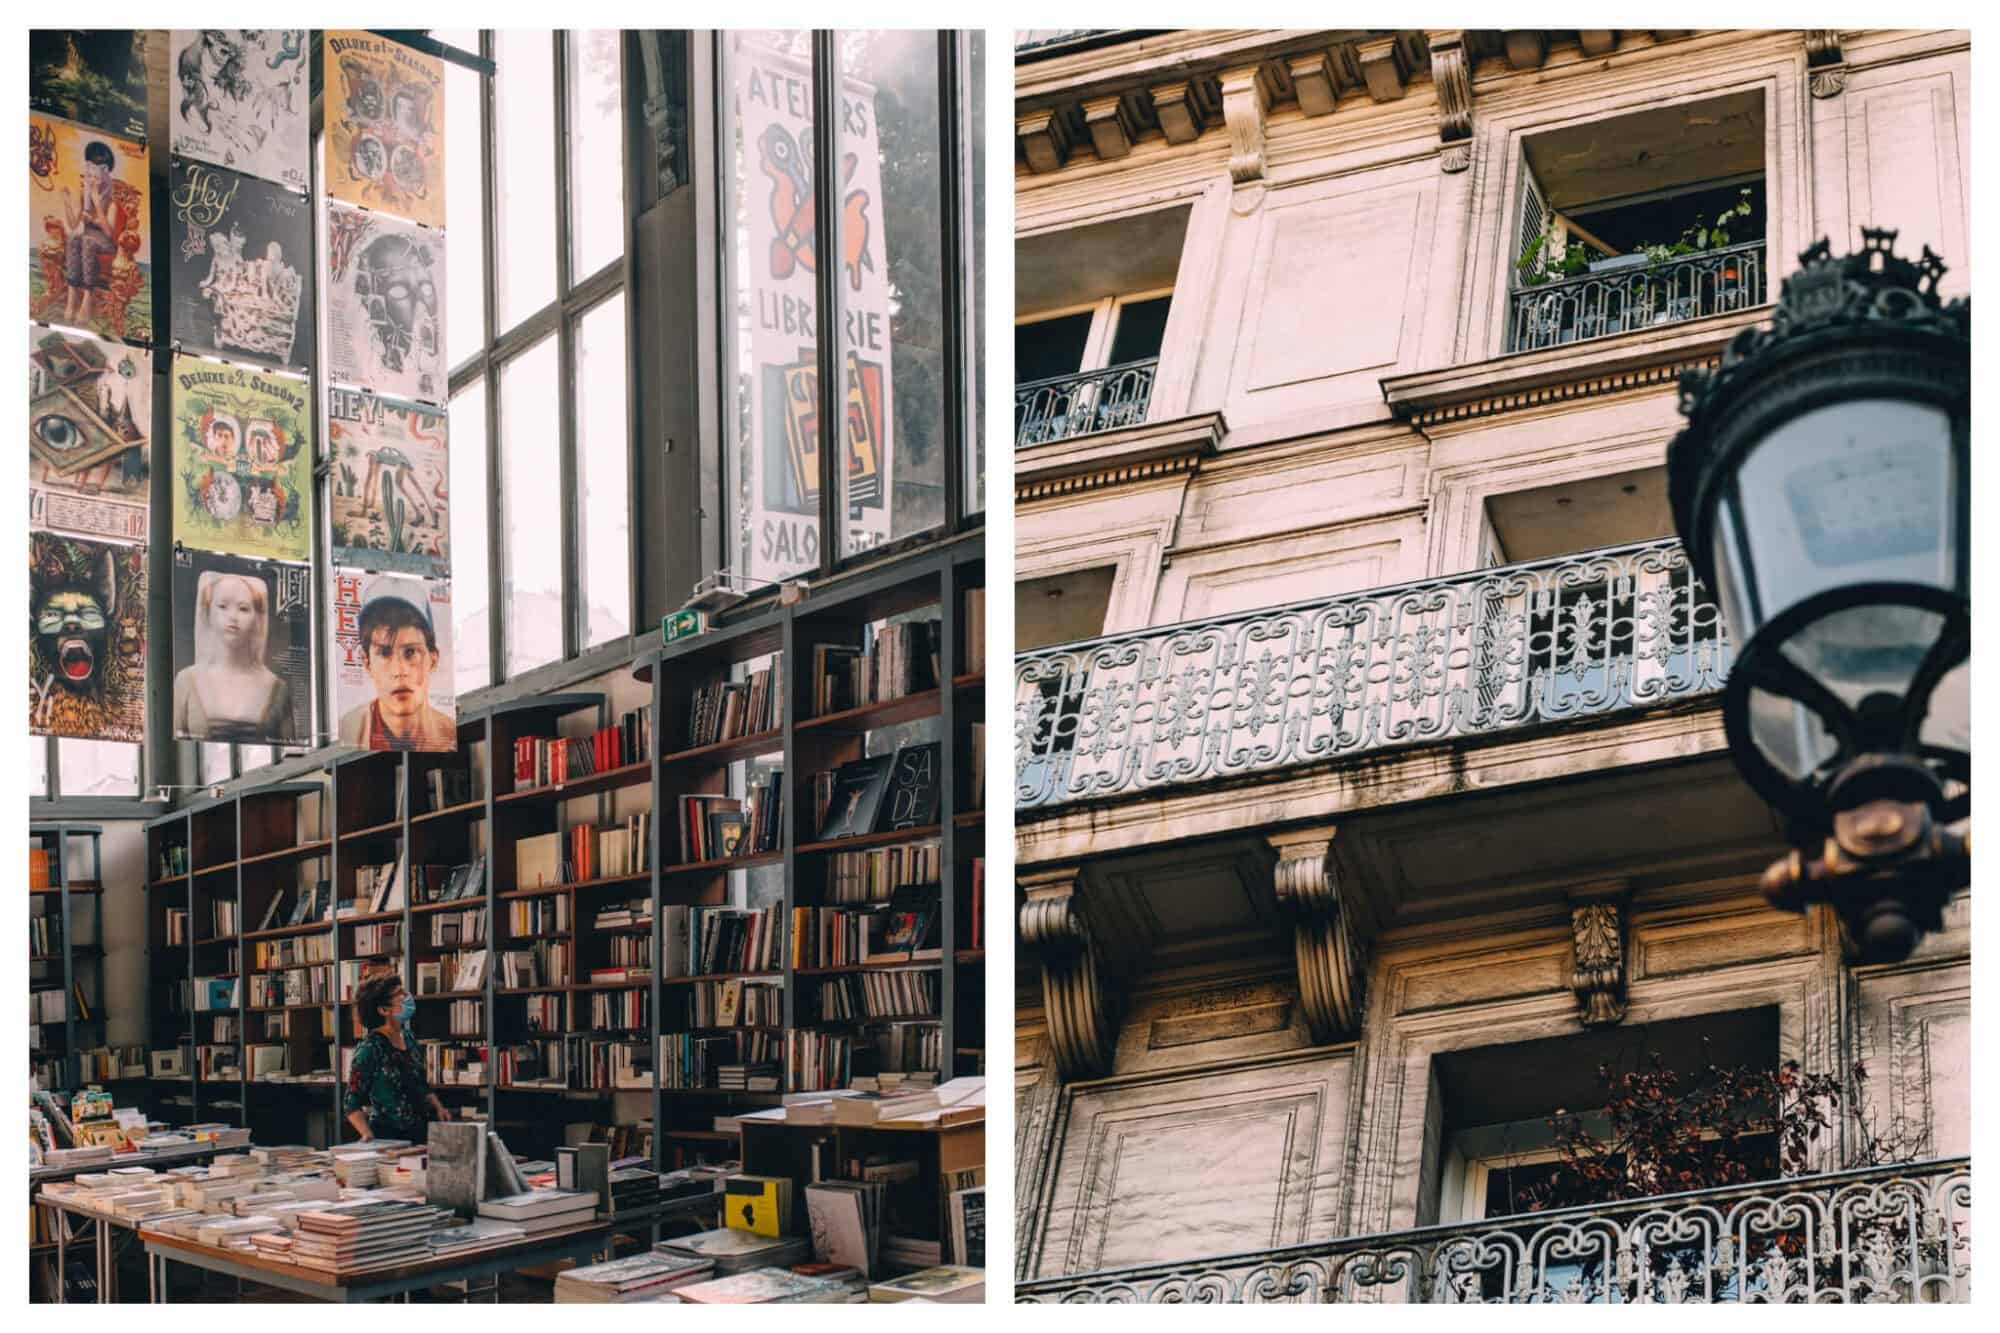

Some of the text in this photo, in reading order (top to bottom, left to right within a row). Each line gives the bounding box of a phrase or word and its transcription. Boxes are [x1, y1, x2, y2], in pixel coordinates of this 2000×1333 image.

[747, 66, 868, 138] ATELRS
[759, 288, 882, 351] LIBRRIE
[760, 519, 819, 565] SALO
